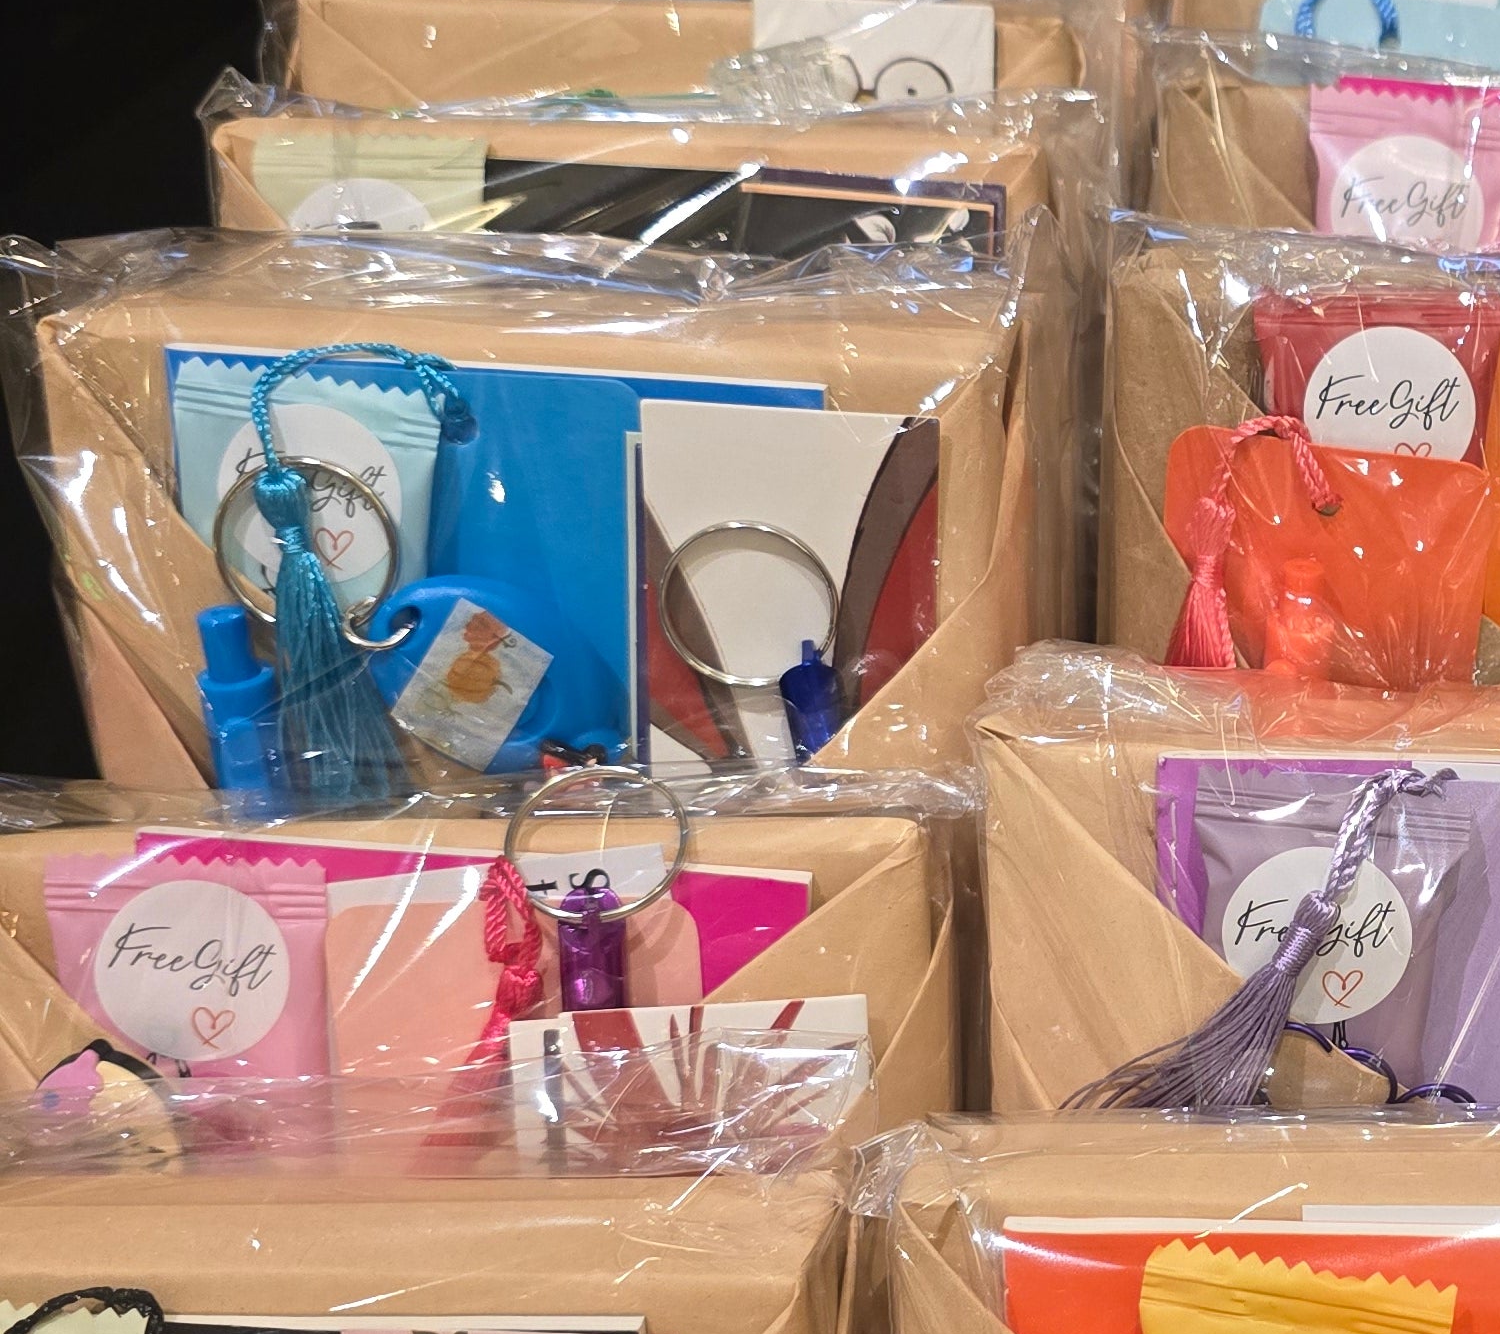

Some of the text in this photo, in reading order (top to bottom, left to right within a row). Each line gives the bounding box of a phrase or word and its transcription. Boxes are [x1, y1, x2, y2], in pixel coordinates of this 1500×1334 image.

[1341, 176, 1471, 228] Free Gift
[1315, 374, 1461, 431] Free Gift
[1234, 898, 1290, 946] Fre
[107, 922, 278, 997] Free Gift
